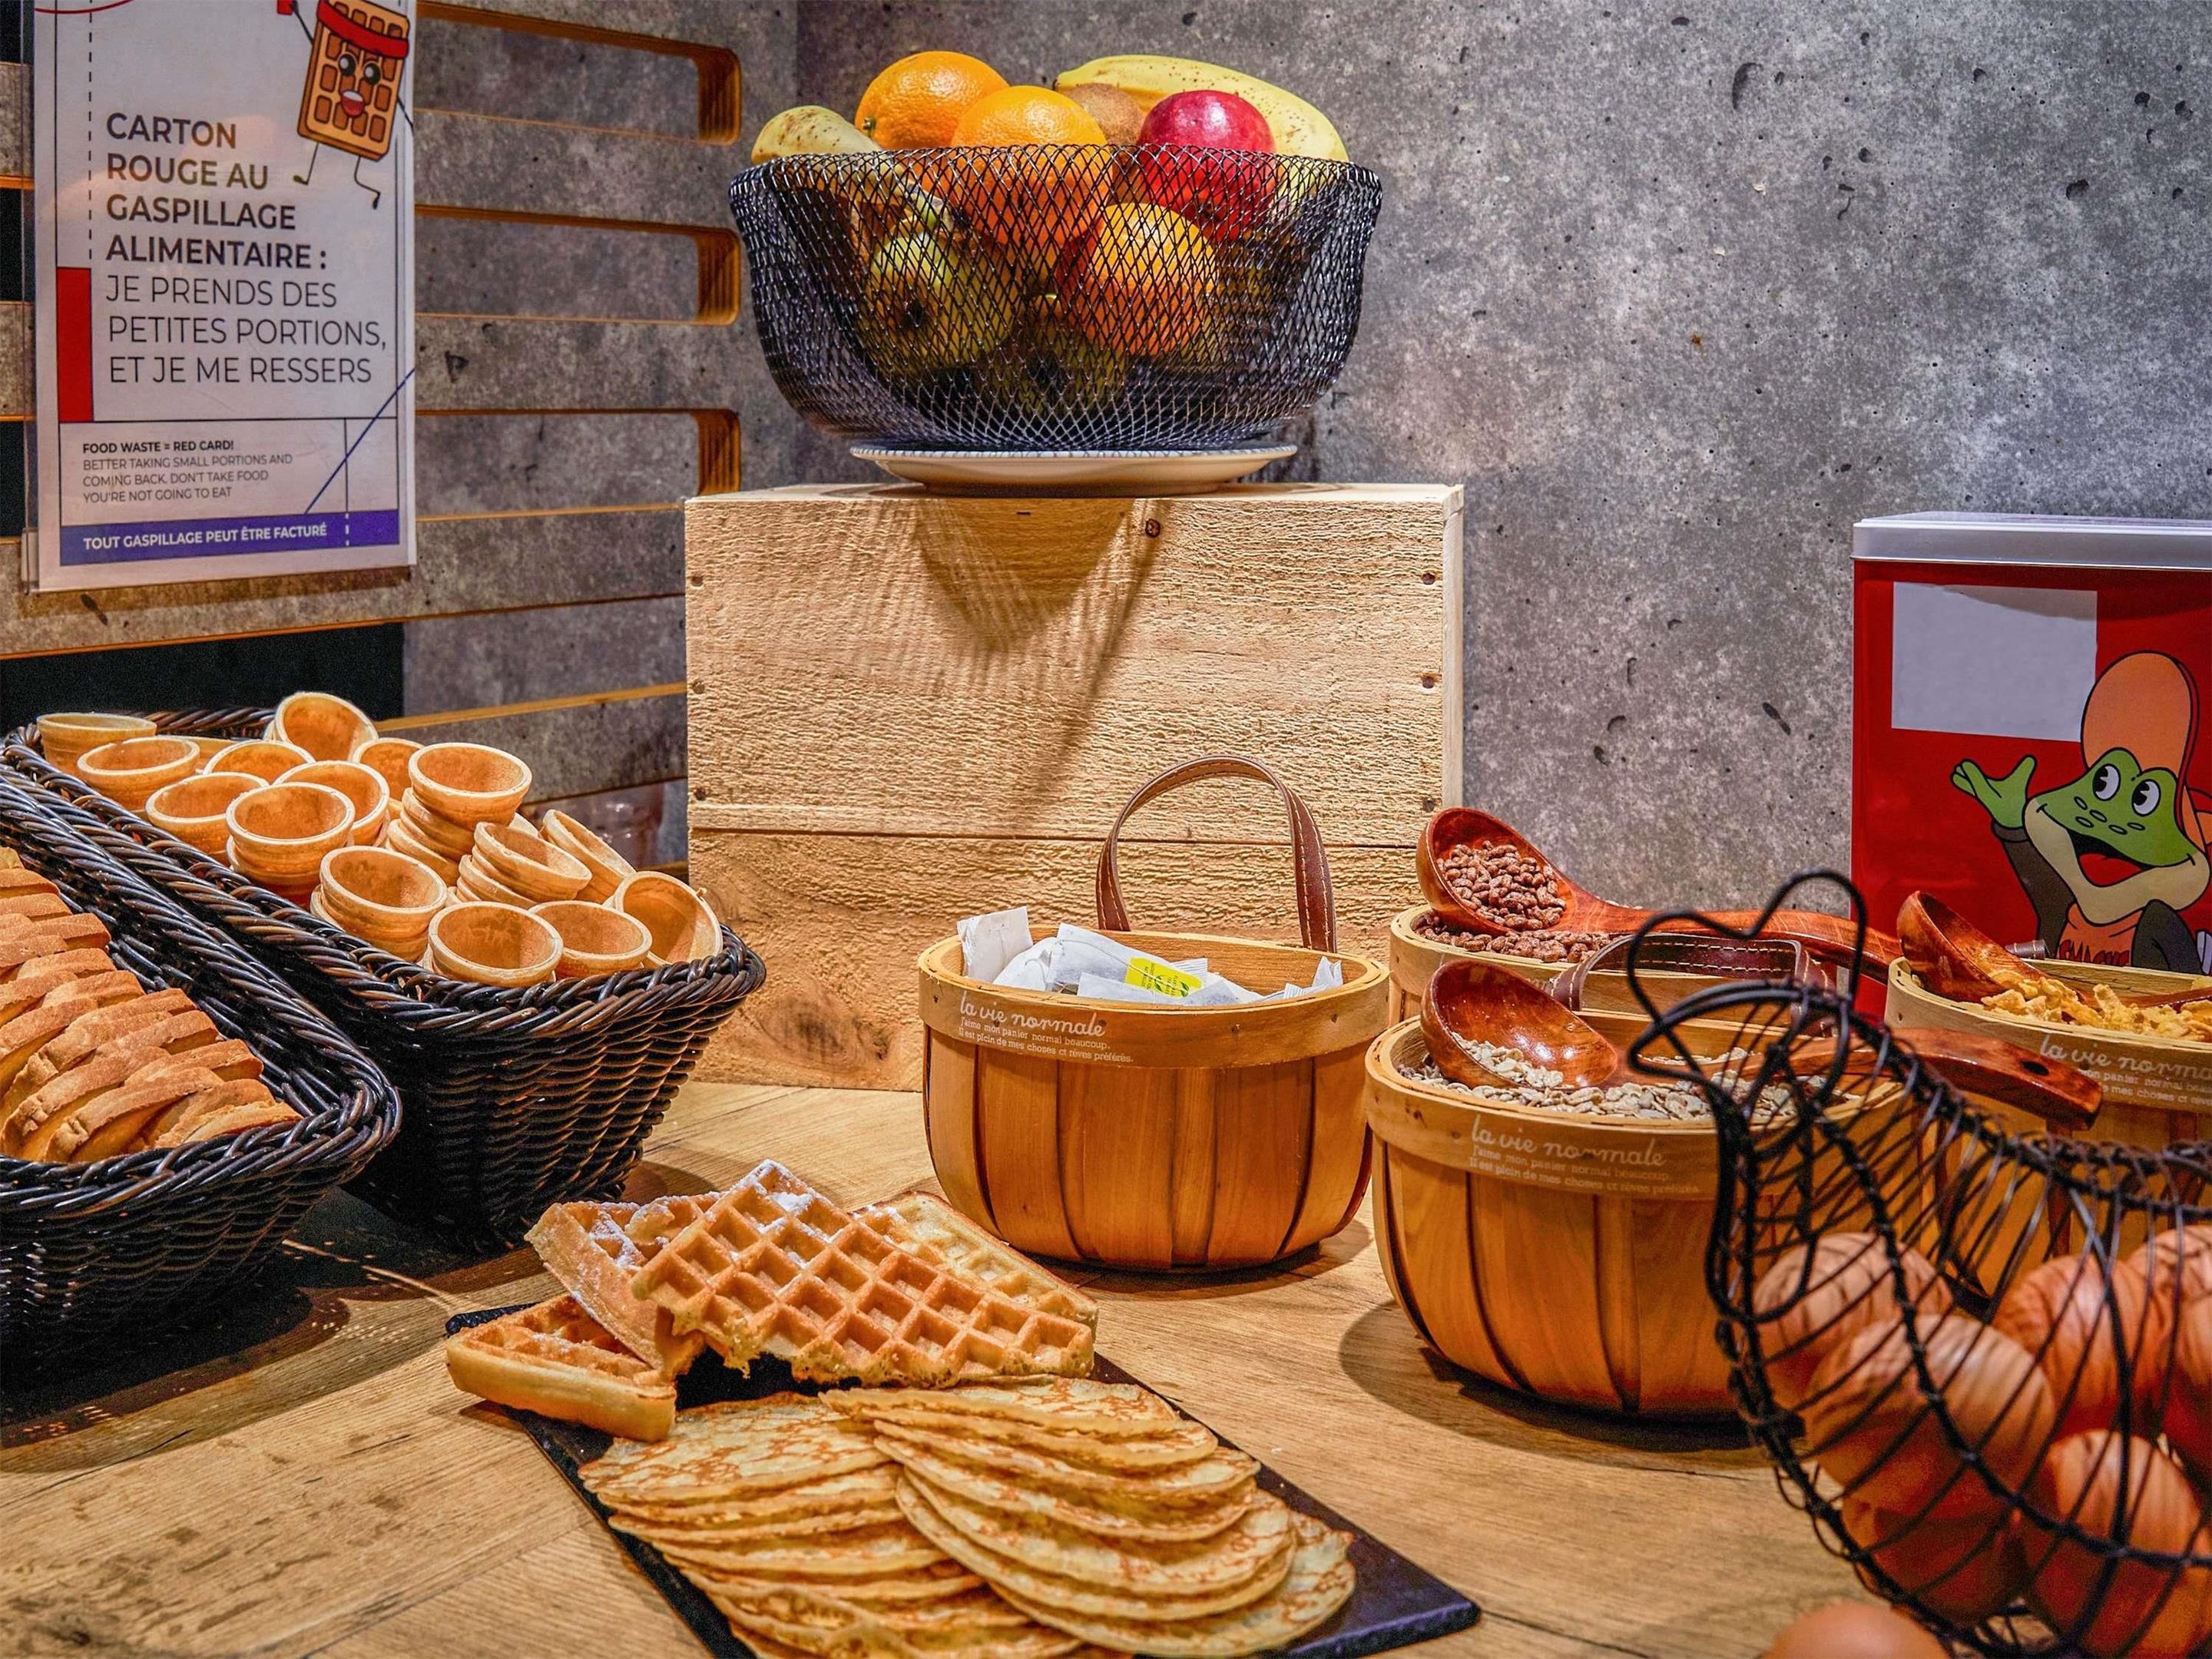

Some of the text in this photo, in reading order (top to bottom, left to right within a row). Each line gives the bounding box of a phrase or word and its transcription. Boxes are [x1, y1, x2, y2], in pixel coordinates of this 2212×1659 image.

[106, 112, 237, 149] CARTON
[107, 153, 268, 190] ROUGE AU
[106, 194, 296, 230] GASPILLAGE
[105, 234, 311, 269] ALIMENTAIRE
[106, 274, 337, 308] JE PRENDS DES
[109, 316, 386, 350] PETITES PORTIONS,
[110, 356, 372, 383] ET JE ME RESSERS
[83, 442, 118, 454] FOOD
[121, 442, 161, 453] WASTE
[174, 441, 197, 452] RED
[199, 440, 234, 451] CARD!
[83, 453, 293, 471] BETTER TAKING SMALL PORTIONS AND
[82, 475, 132, 487] COMING
[171, 472, 205, 484] DON'T
[207, 471, 234, 482] TAKE
[237, 470, 269, 481] FOOD
[83, 487, 233, 504] YOU'RE NOT GOING TO EAT
[83, 522, 327, 551] TOUT GASPILLAGE PEUT ÊTRE FACTURÉ
[960, 990, 1106, 1037] la vie normale
[965, 1030, 975, 1038] est
[997, 1037, 1007, 1045] de
[1008, 1041, 1025, 1049] mes
[1027, 1043, 1057, 1055] choses
[984, 1025, 1001, 1035] mon
[1002, 1028, 1028, 1039] panier
[1032, 1033, 1062, 1045] normal
[2040, 1034, 2068, 1060] la
[2071, 1043, 2111, 1066] vie
[1472, 1114, 1667, 1166] la vie normale
